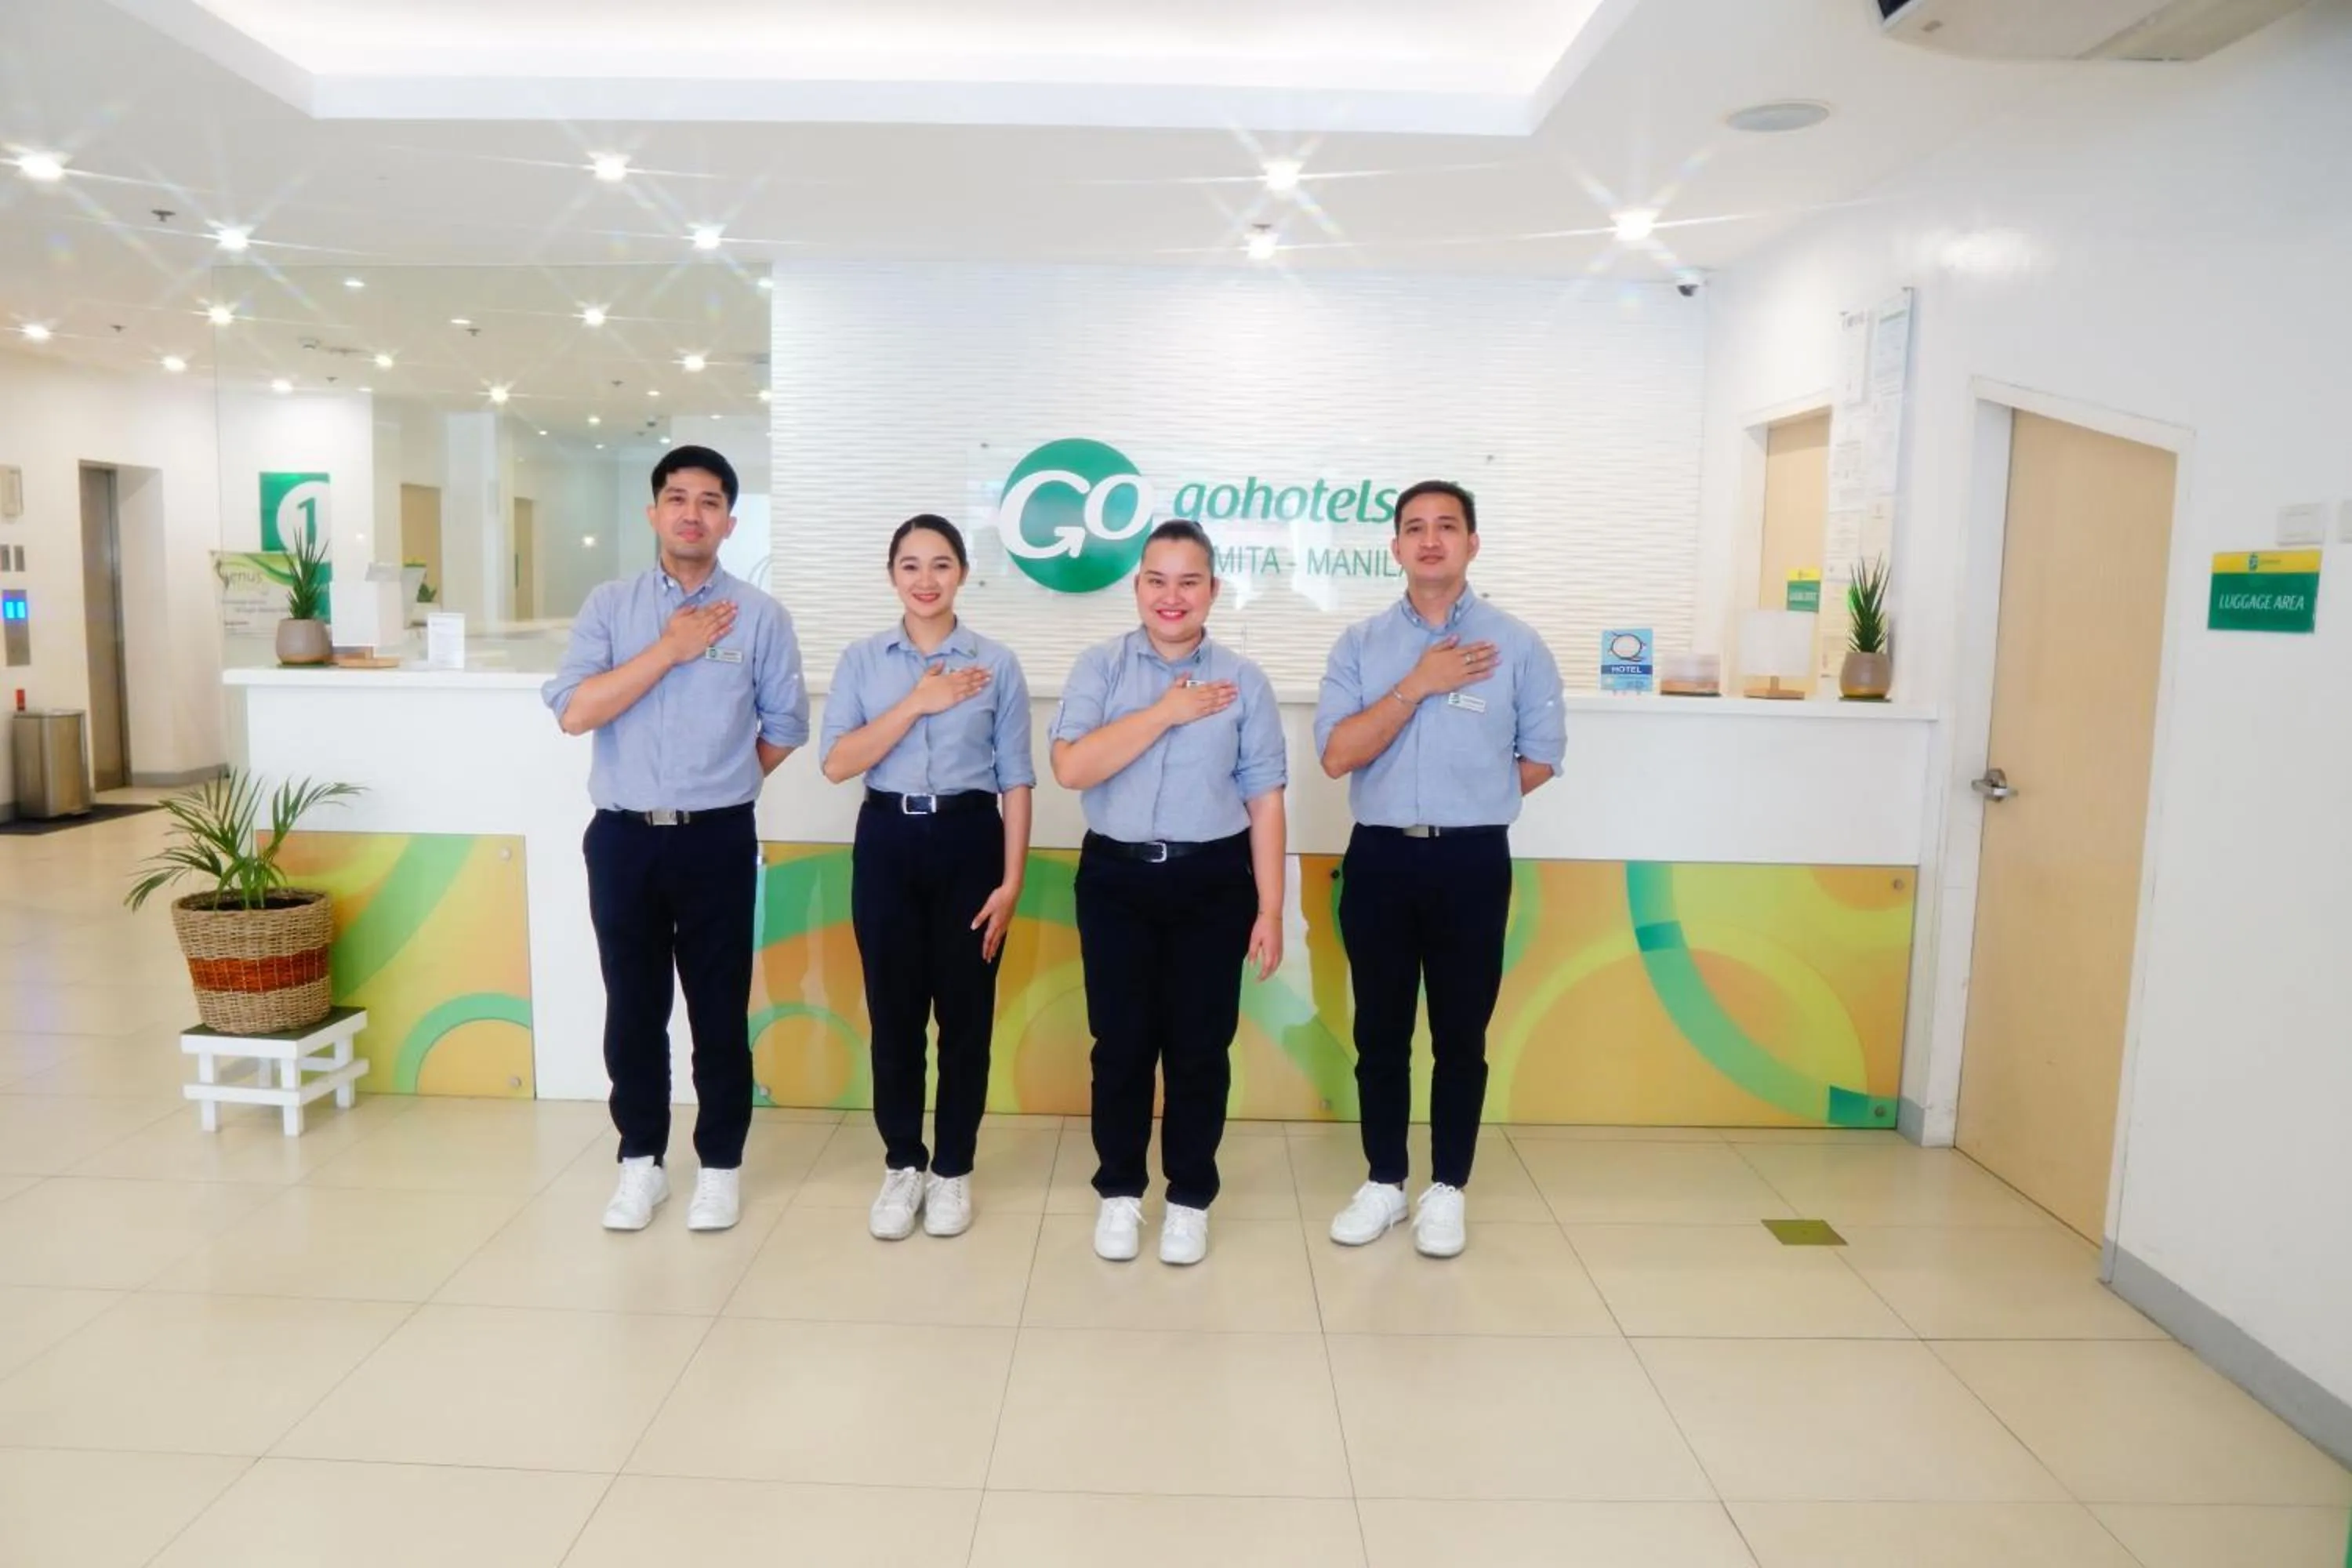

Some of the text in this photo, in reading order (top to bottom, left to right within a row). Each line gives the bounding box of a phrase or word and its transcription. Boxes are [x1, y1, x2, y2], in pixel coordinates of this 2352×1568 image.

[1173, 476, 1475, 524] gohotels
[1213, 546, 1280, 574] MITA
[1307, 546, 1404, 578] MANIL
[2218, 594, 2304, 611] LUGGAGE AREA
[1611, 665, 1643, 673] HOTEL
